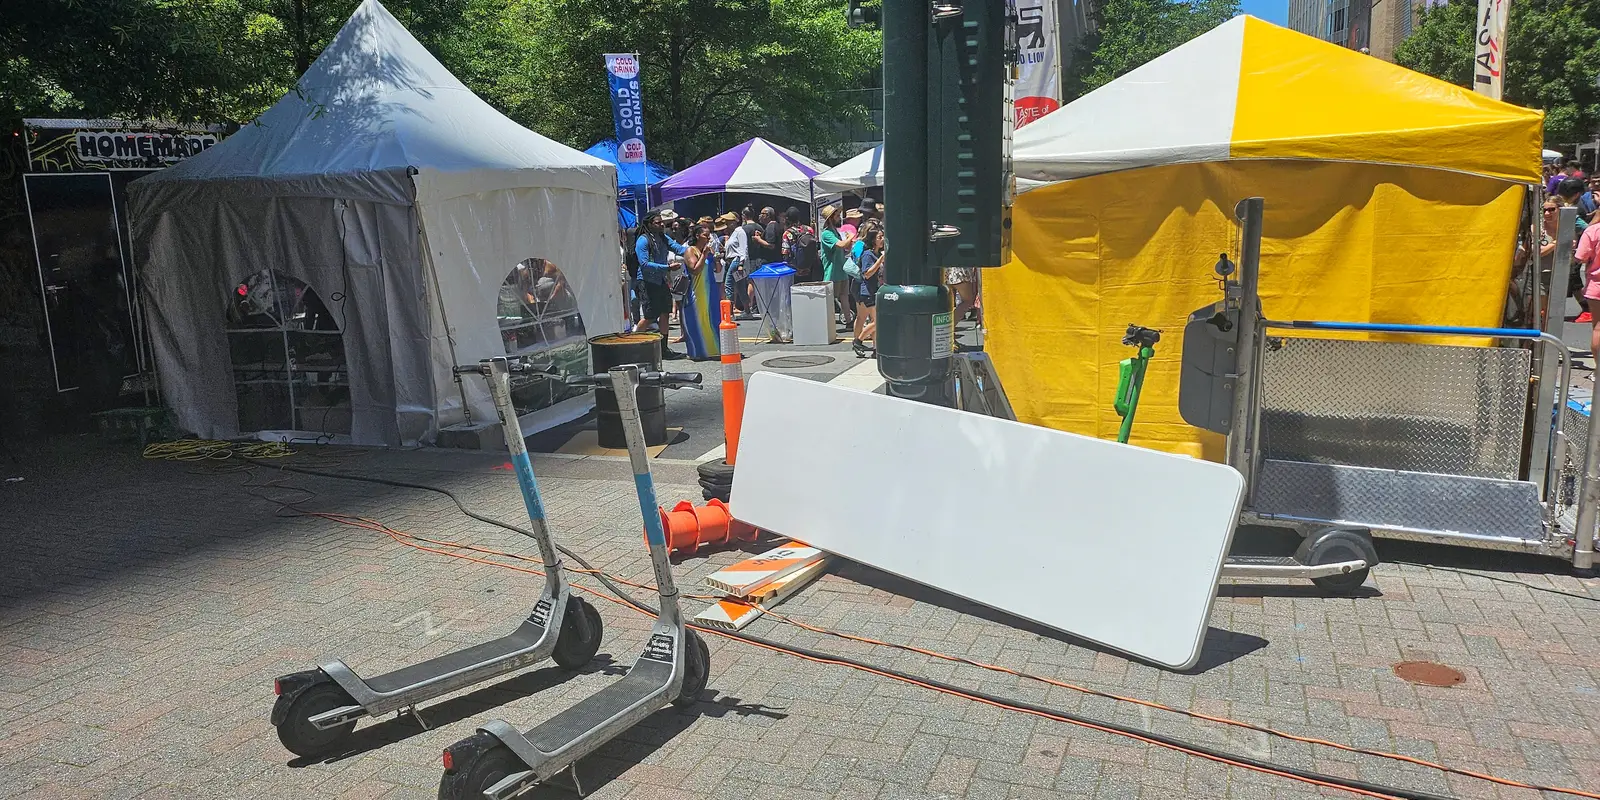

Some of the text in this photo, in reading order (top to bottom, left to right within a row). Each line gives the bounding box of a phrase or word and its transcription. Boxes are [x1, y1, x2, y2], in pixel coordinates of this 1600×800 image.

[615, 57, 633, 65] COLD
[1028, 51, 1045, 64] LION
[617, 87, 634, 129] COLD
[629, 80, 643, 136] DRINKS
